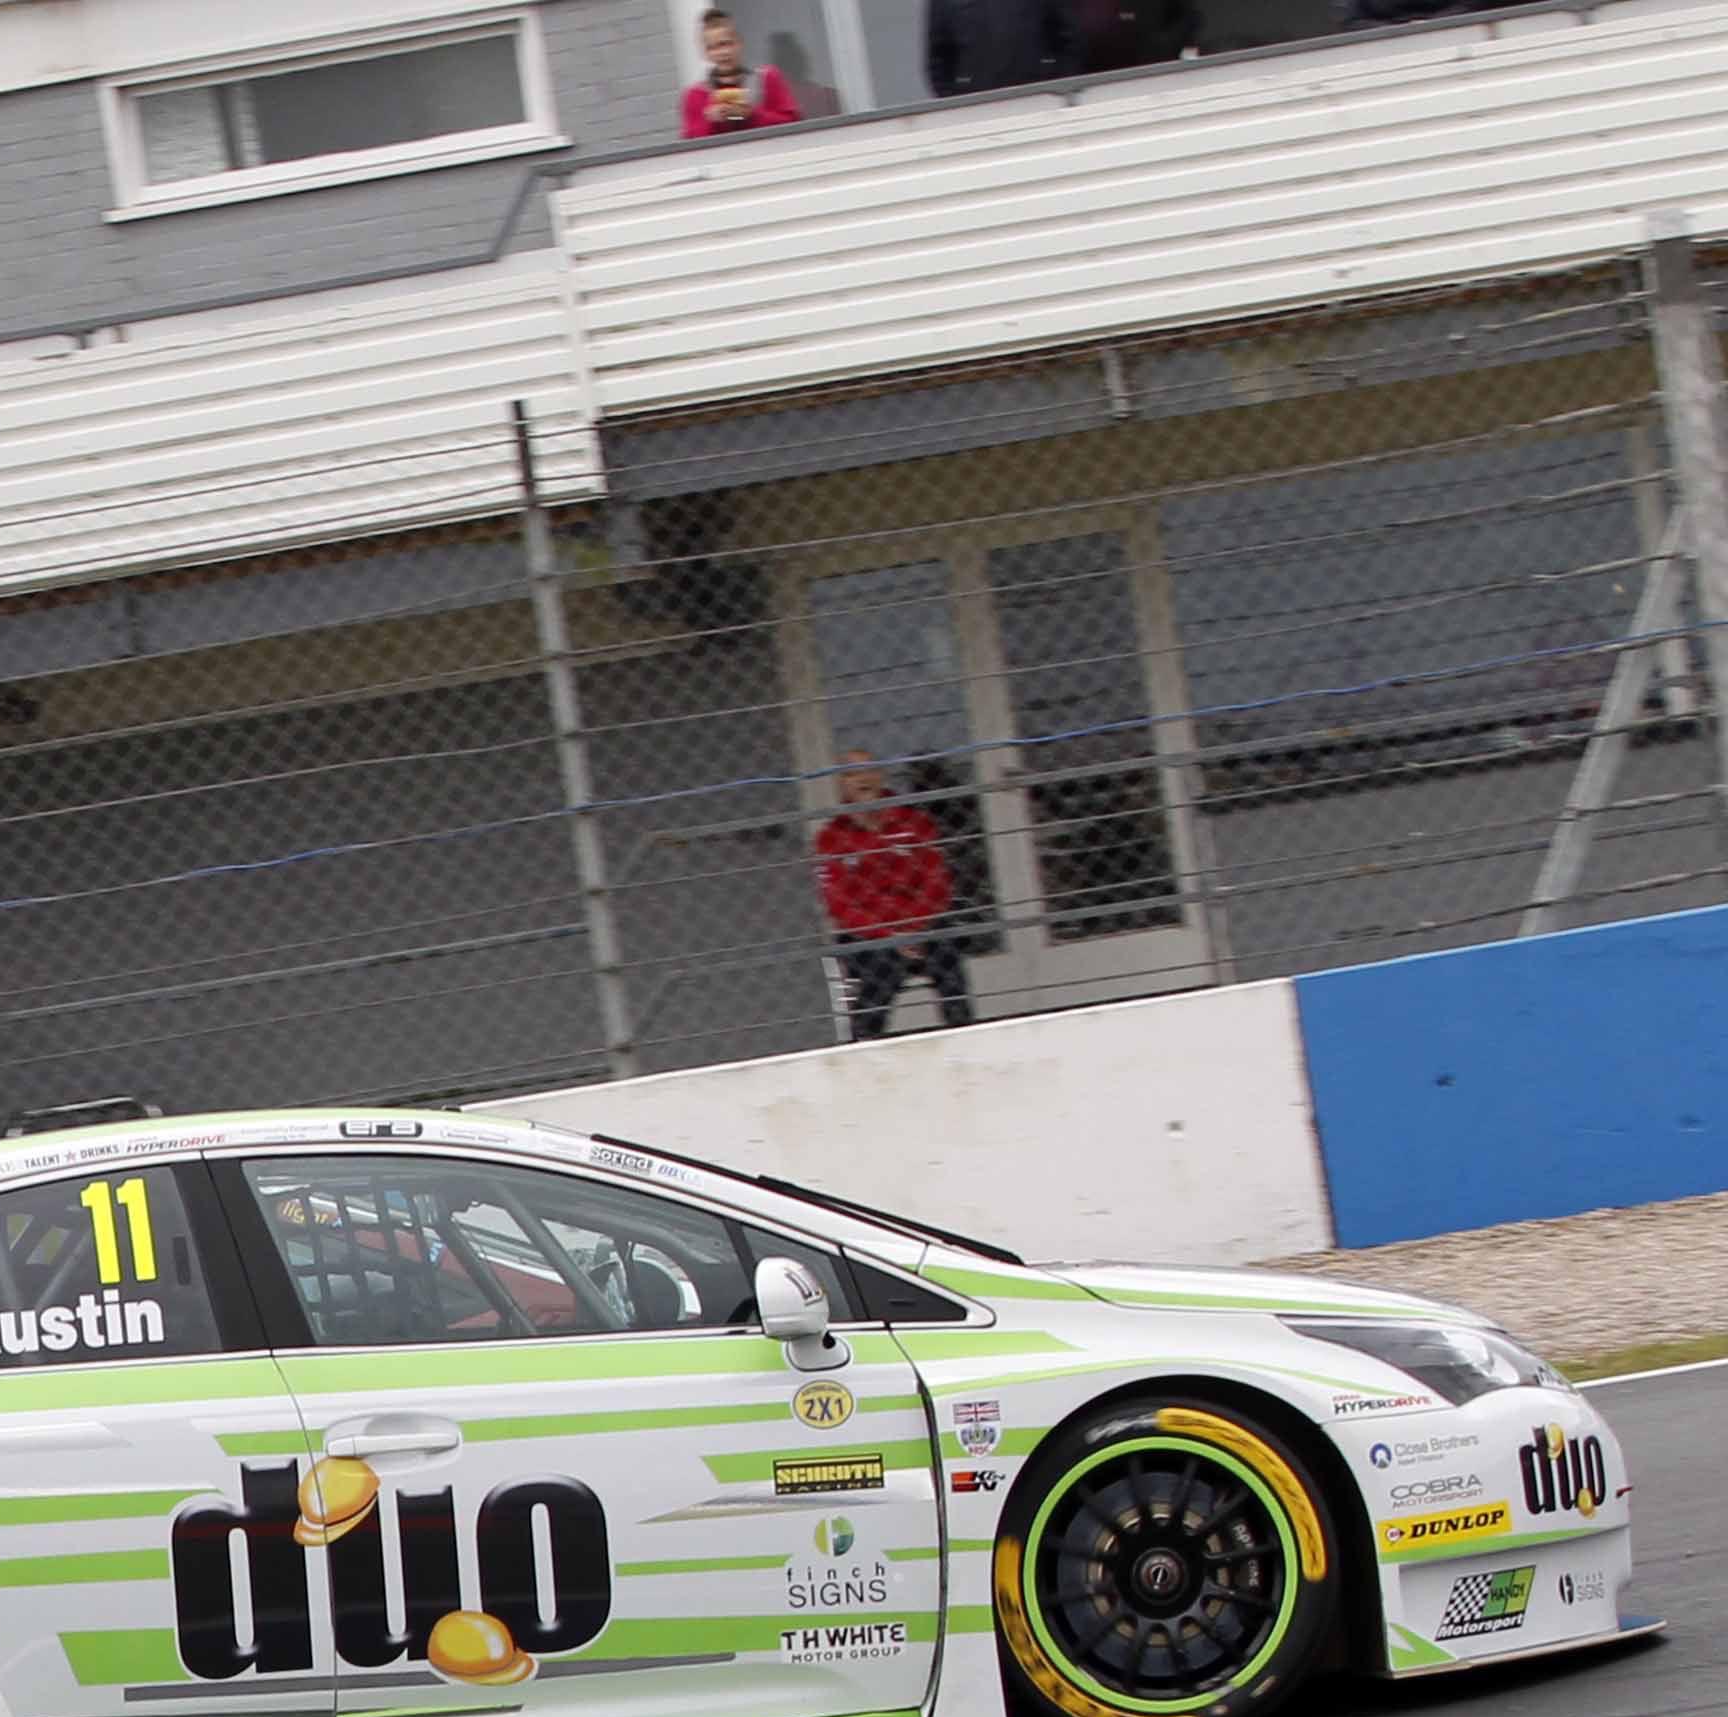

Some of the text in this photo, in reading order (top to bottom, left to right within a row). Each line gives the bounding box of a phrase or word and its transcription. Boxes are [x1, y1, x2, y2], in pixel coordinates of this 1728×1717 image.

[126, 1134, 226, 1153] HYPERDRIVE
[24, 1144, 120, 1169] TALENT DRINKS
[80, 1177, 157, 1285] 11
[803, 1397, 844, 1421] 2X1
[1334, 1396, 1432, 1415] HYPERDRIVE
[1430, 1435, 1480, 1452] Brothers
[777, 1463, 881, 1485] SCHROTH
[1519, 1423, 1607, 1516] duo
[1390, 1474, 1483, 1500] COBRA
[1392, 1488, 1484, 1509] MOTORSPORT
[1410, 1510, 1505, 1539] DUNLOP
[170, 1456, 613, 1681] duo
[788, 1579, 887, 1609] SIGNS
[1490, 1582, 1526, 1600] HANDY
[826, 1623, 905, 1647] WHITE
[1436, 1613, 1525, 1639] Motorsport
[792, 1646, 902, 1664] MOTOR GROUP
